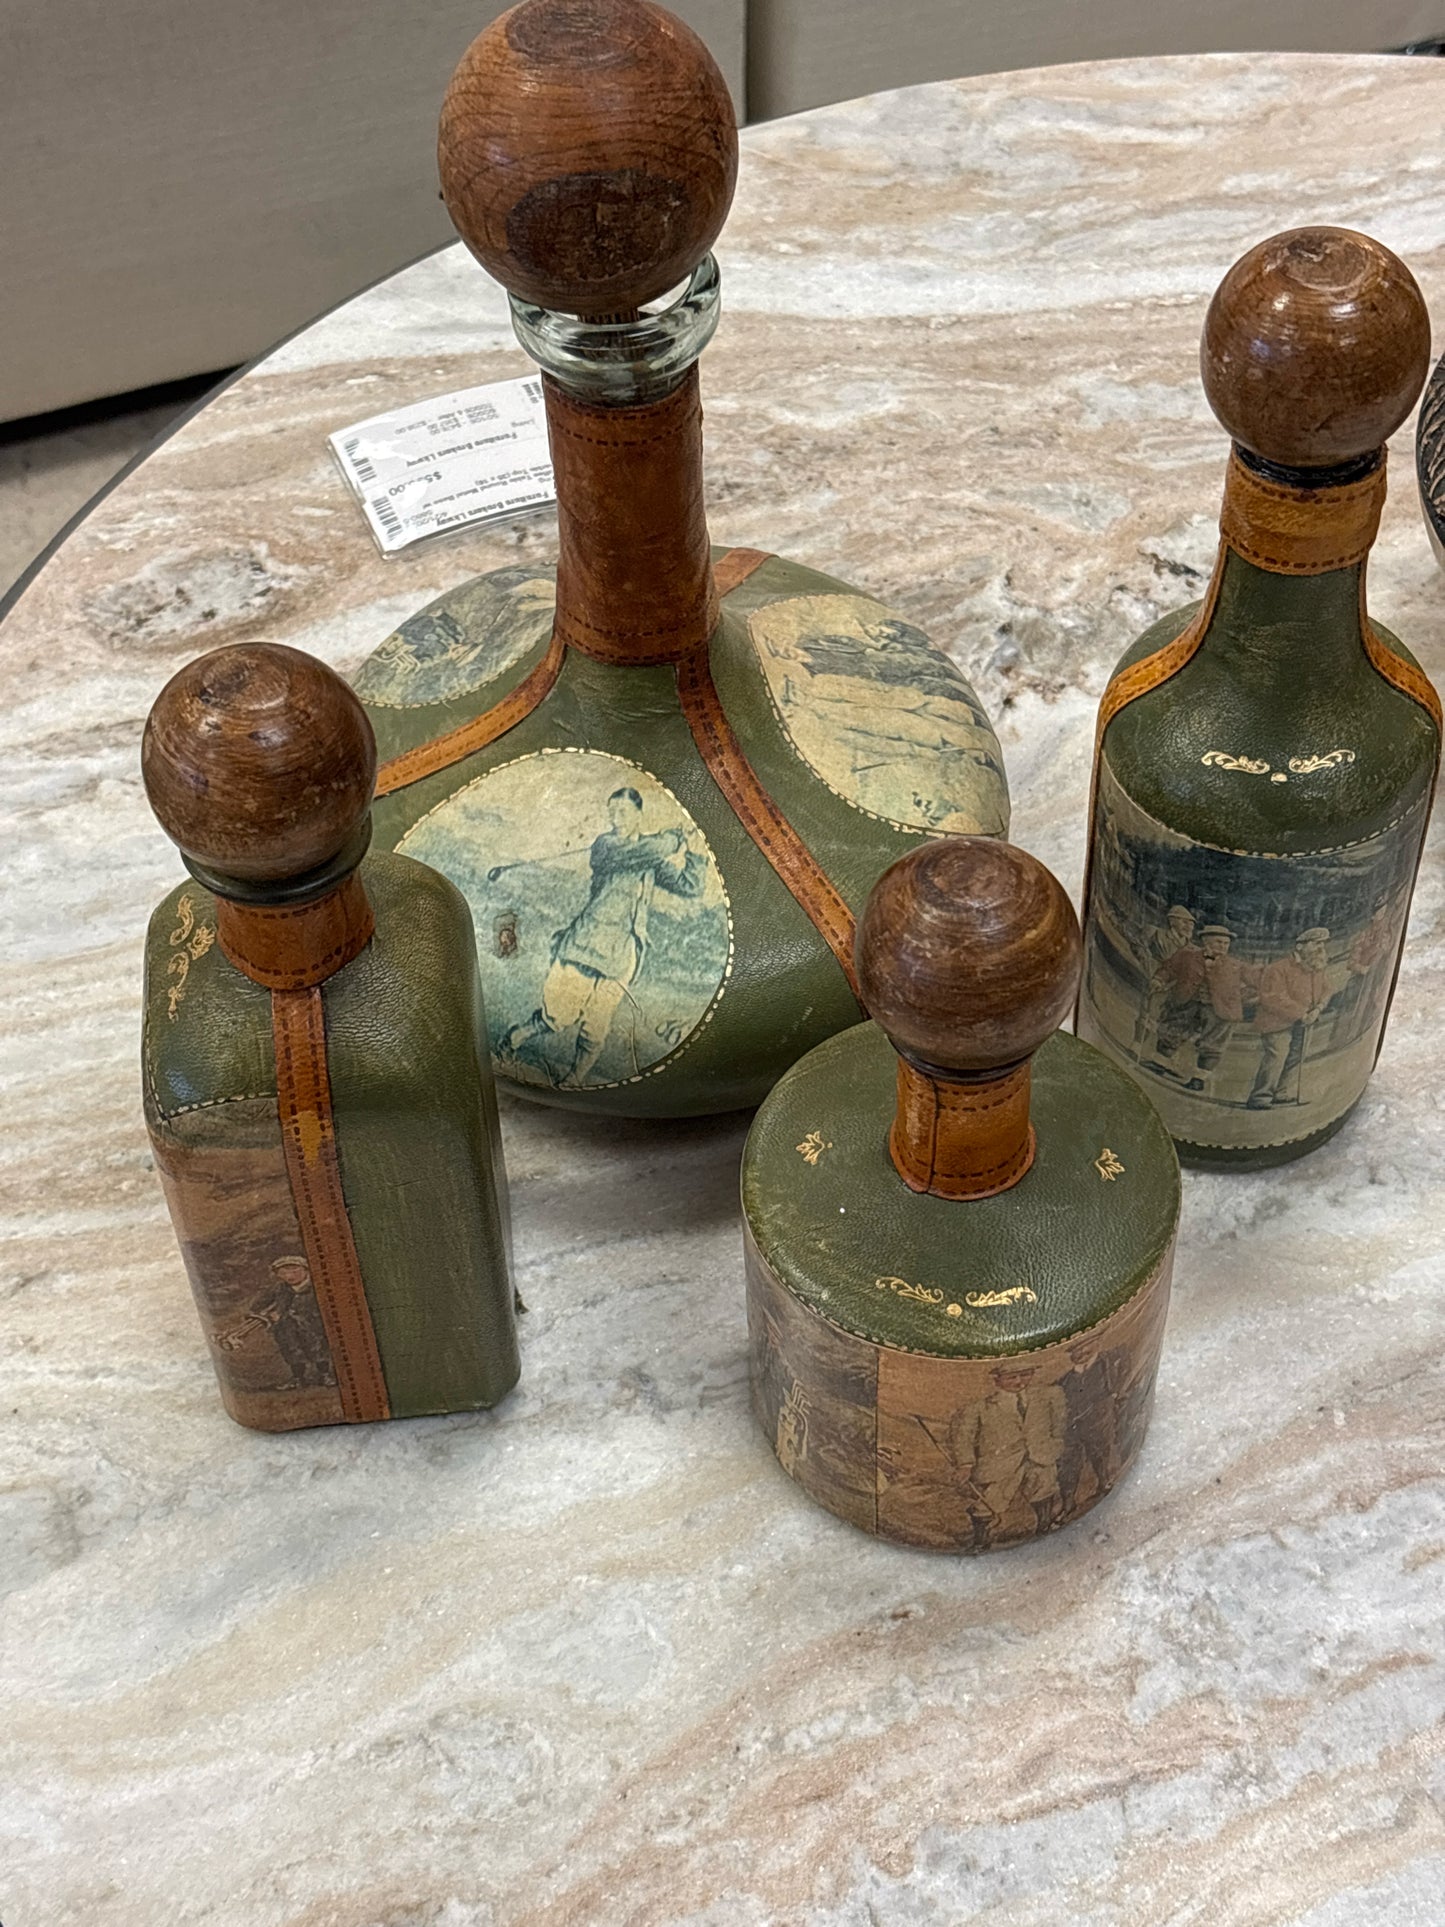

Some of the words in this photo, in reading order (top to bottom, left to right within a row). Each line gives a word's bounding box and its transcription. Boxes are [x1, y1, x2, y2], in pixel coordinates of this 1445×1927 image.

[474, 432, 517, 446] Furniture
[437, 442, 473, 457] Brokers
[388, 471, 442, 496] $5.00
[505, 491, 549, 505] Furniture
[467, 501, 504, 516] Brokers
